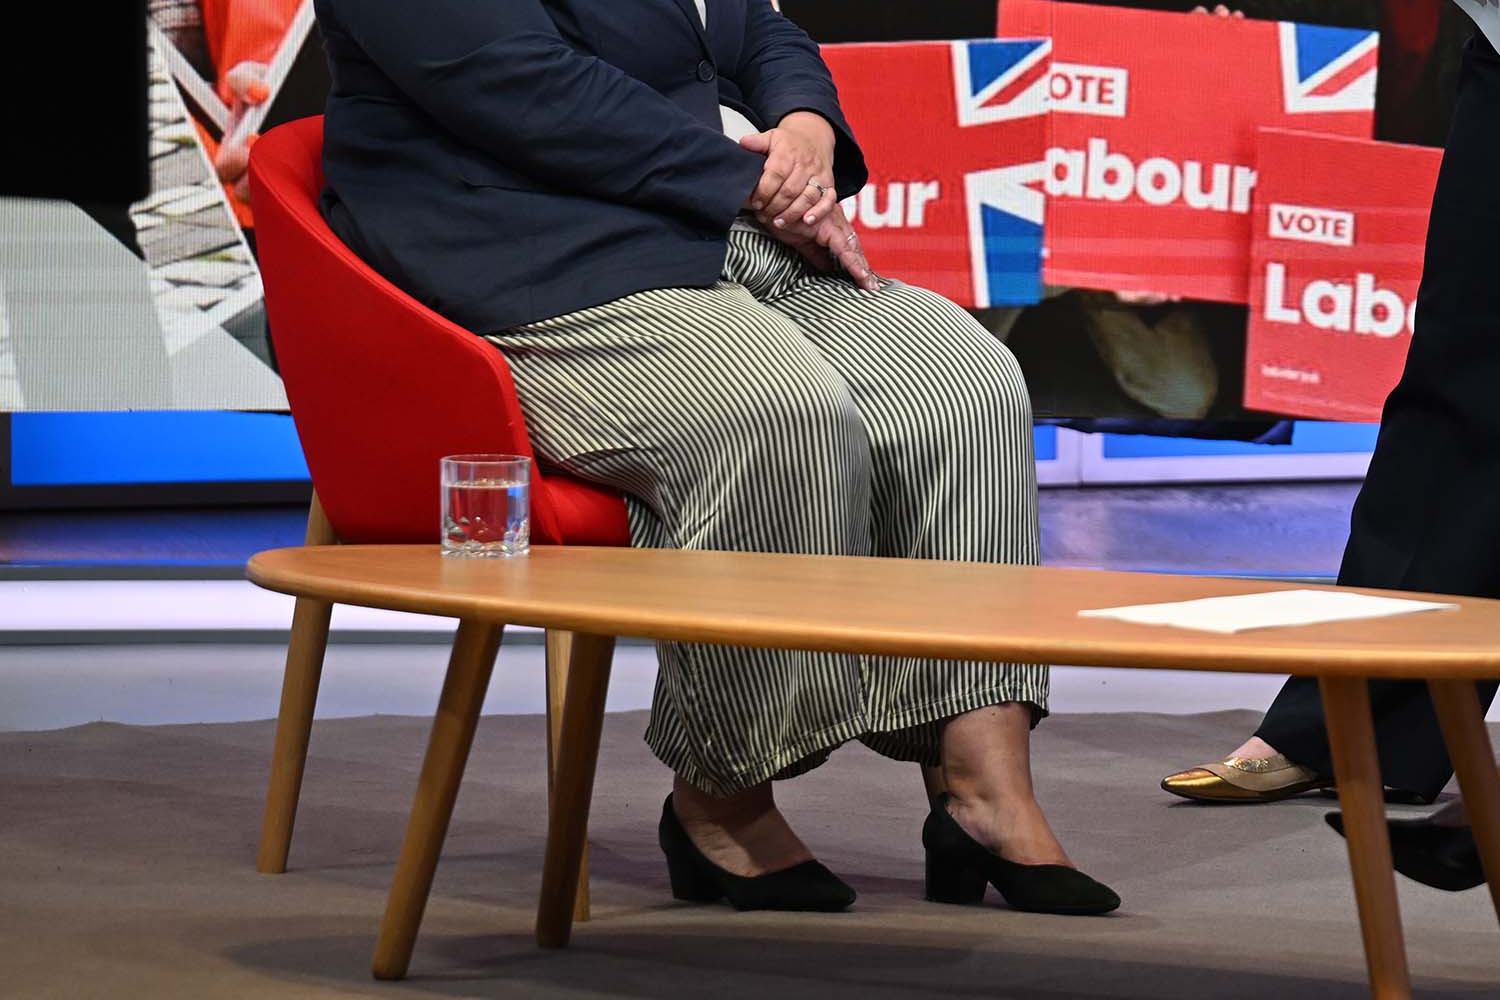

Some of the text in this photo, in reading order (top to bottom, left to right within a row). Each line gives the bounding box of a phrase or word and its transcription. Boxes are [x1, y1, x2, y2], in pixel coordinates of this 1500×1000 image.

[1049, 72, 1115, 105] OTE
[1043, 137, 1257, 213] abour
[1277, 210, 1347, 238] VOTE
[1264, 262, 1417, 338] Lab
